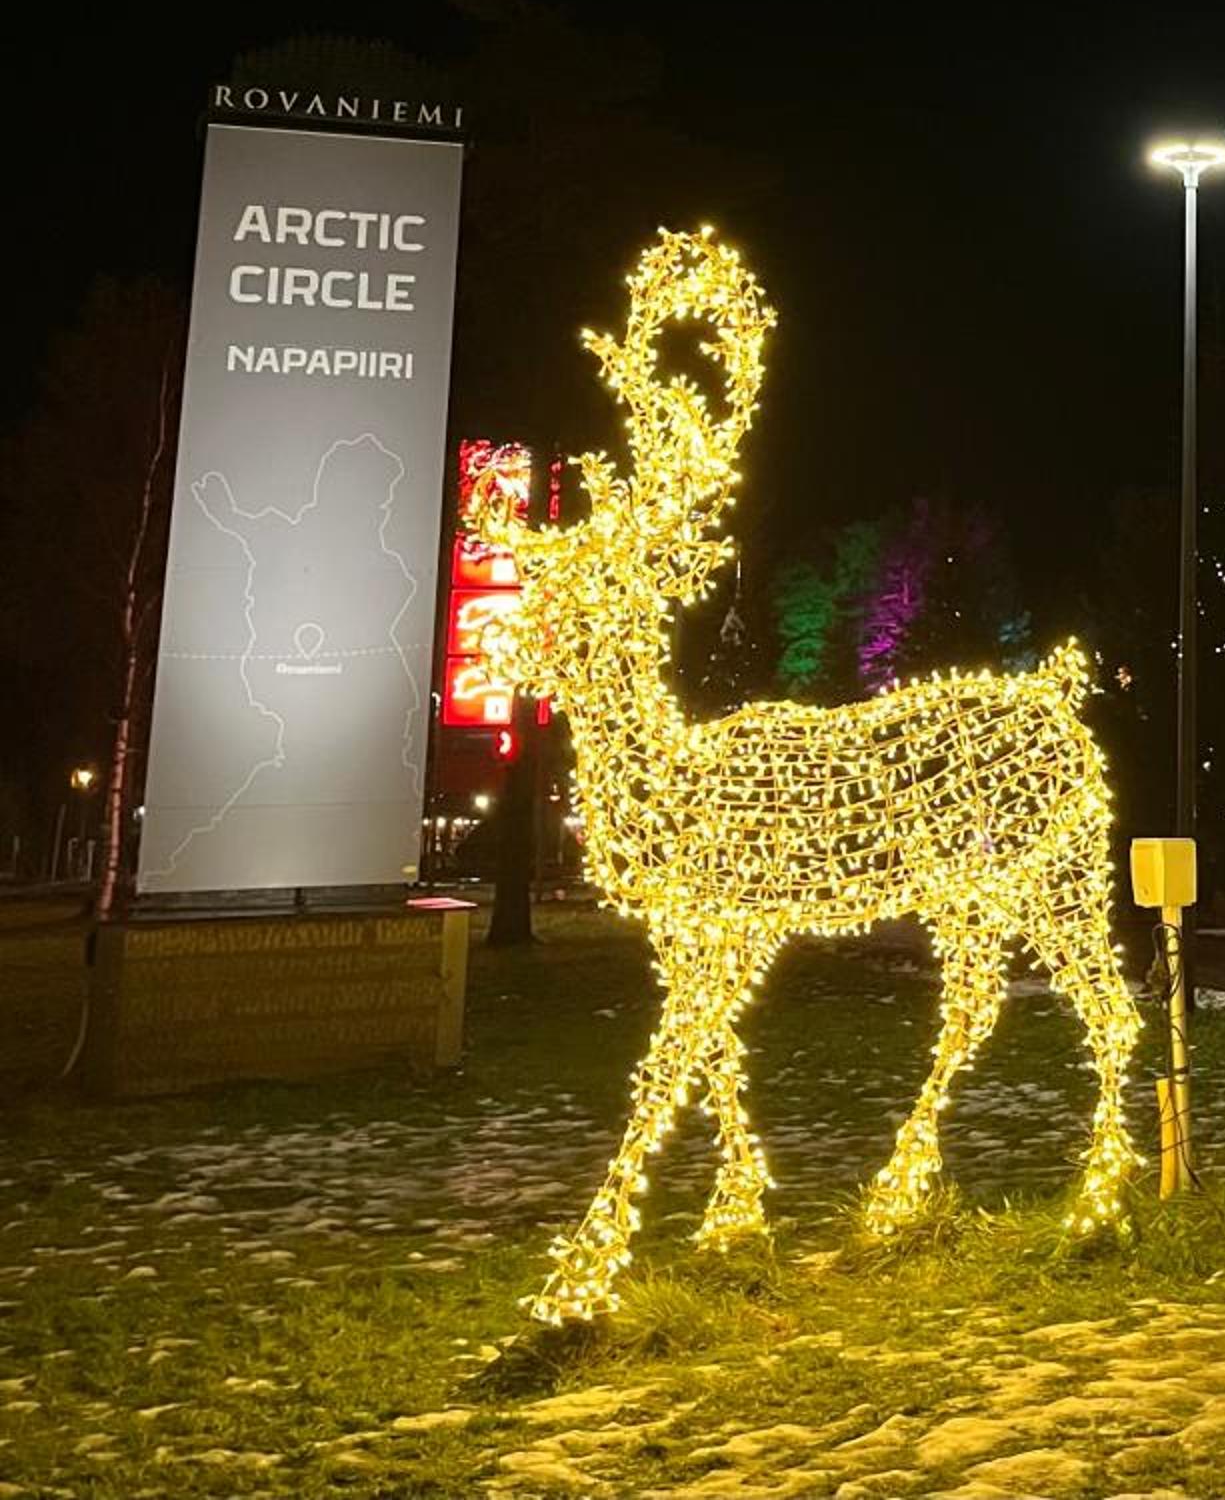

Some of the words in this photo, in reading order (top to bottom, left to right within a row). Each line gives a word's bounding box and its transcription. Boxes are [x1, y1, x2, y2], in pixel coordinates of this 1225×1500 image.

[215, 84, 463, 128] ROVANIEMI
[234, 205, 426, 251] ARCTIC
[229, 265, 416, 311] CIRCLE
[227, 345, 414, 379] NAPAPIIRI
